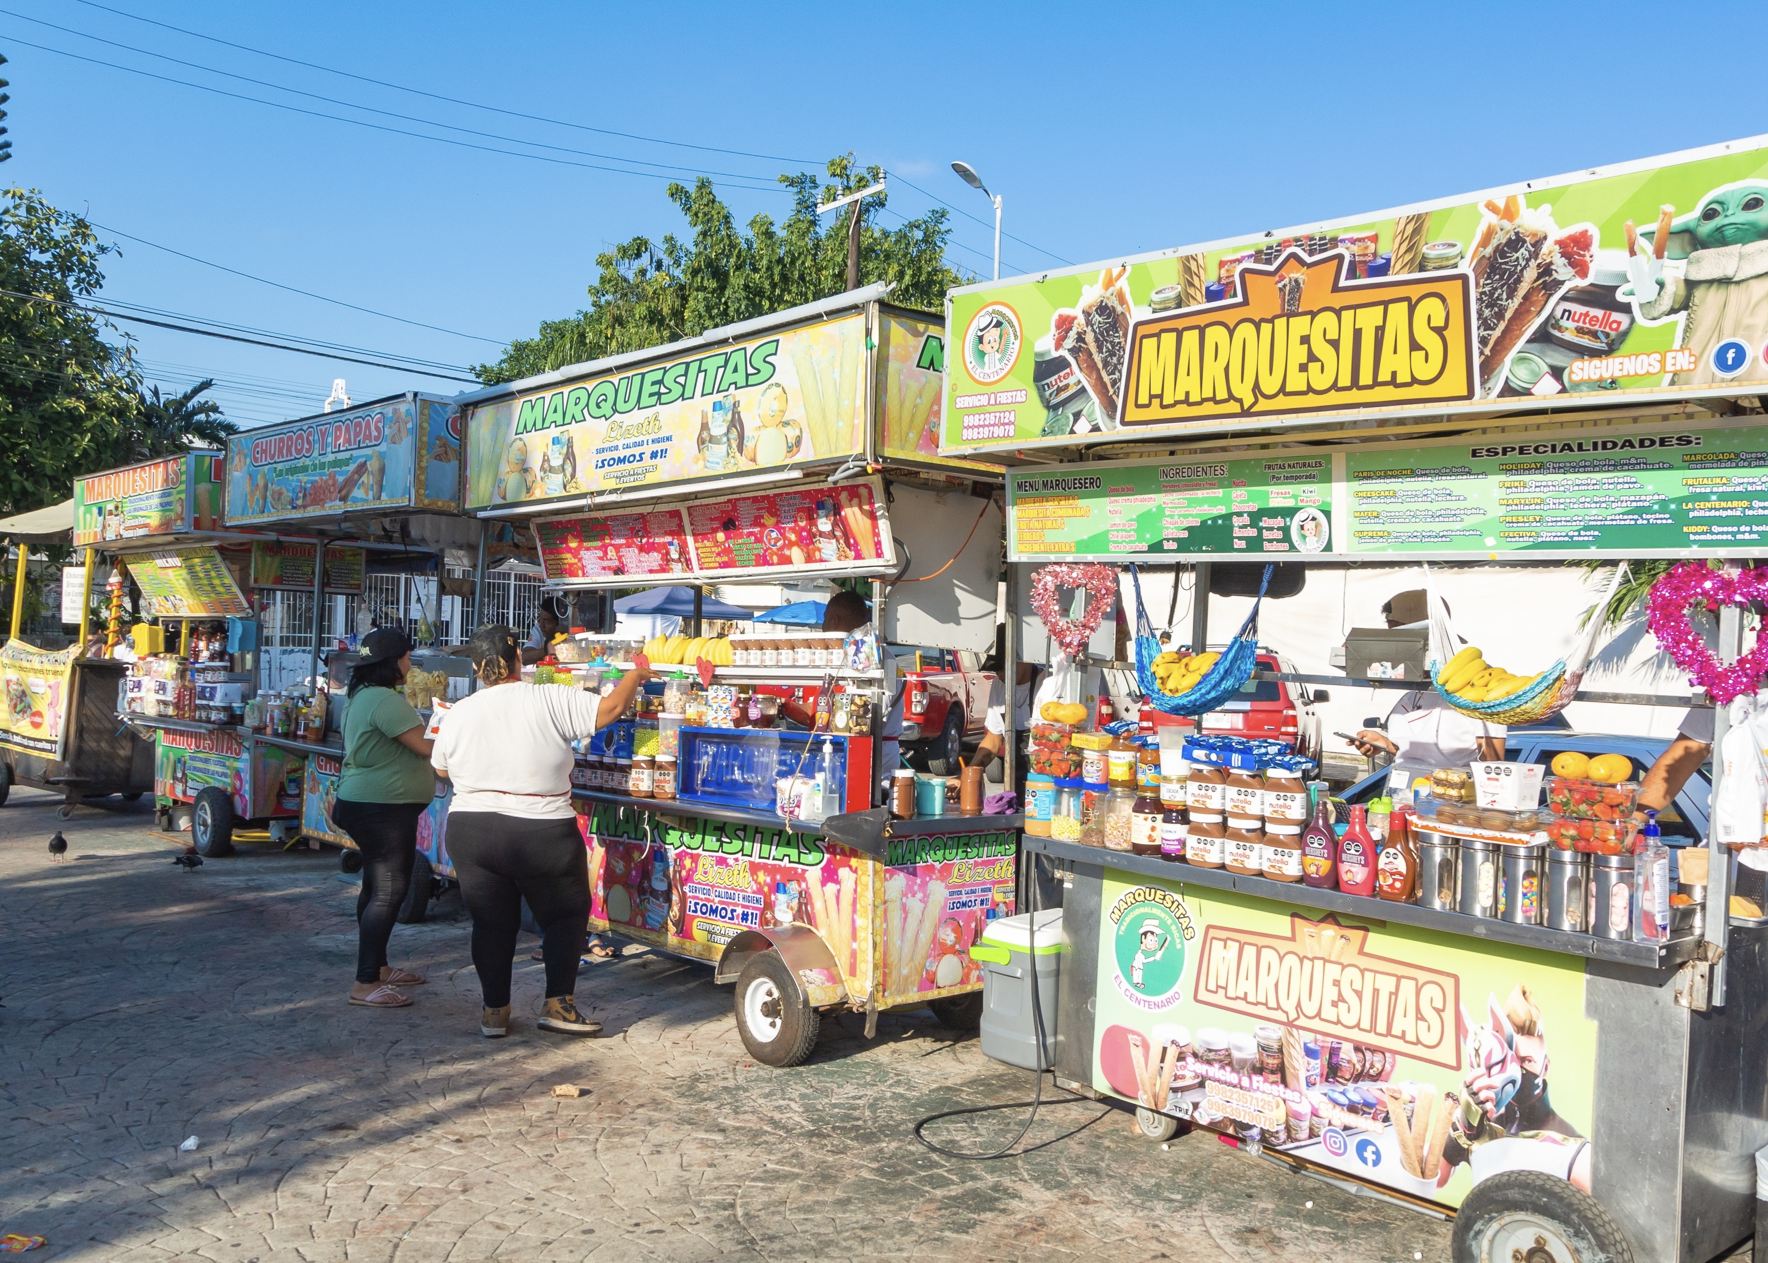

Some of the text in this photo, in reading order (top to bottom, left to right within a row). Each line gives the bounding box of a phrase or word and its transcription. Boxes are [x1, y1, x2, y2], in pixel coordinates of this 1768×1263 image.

[1560, 307, 1623, 333] nutella
[1135, 296, 1450, 413] MARQUESITAS
[1665, 350, 1695, 371] EN:
[978, 347, 1016, 380] CENTENARIO
[515, 338, 780, 436] MARQUESITAS
[1042, 368, 1076, 392] nutel
[955, 390, 1026, 408] SERVICIO A FIESTAS
[602, 412, 662, 443] Lizeth
[251, 427, 315, 467] CHURROS
[316, 423, 331, 455] Y
[332, 412, 385, 453] PAPAS
[622, 440, 645, 450] CALIDAD
[651, 435, 673, 444] HIGIENE
[1471, 434, 1703, 459] ESPECIALIDADES:
[595, 448, 668, 469] ¡SOMOS #1!
[1545, 461, 1577, 469] Queso
[1620, 457, 1647, 465] m&m
[1682, 451, 1767, 462] MARCOLADA: Queso
[604, 469, 631, 479] SERVICIO
[634, 465, 657, 475] FIESTAS
[1159, 465, 1228, 479] INGREDIENTES:
[1264, 461, 1324, 471] FRUTAS NATURALES:
[1505, 468, 1568, 477] philadelphia,
[1600, 464, 1615, 472] de
[1616, 462, 1673, 471] cacahuate.
[1689, 461, 1737, 469] mermelada
[84, 458, 181, 505] MARQUESITAS
[1042, 477, 1102, 492] MARQUESERO
[1270, 473, 1318, 482] (Por temporada)
[1528, 479, 1561, 488] Queso
[1602, 476, 1637, 484] nutella
[1682, 476, 1759, 486] FRUTALIKA: Queso
[1569, 483, 1600, 492] jamón
[1601, 482, 1615, 490] de
[1616, 482, 1644, 491] pavo.
[1712, 485, 1745, 493] natural,
[1747, 484, 1768, 492] kiwi,
[1505, 500, 1653, 512] philadelphia, lechera, plátano.
[1545, 497, 1577, 505] Queso
[1620, 494, 1669, 502] mazapán,
[1682, 500, 1750, 510] LA CENTENARIO:
[1607, 513, 1642, 521] plátano,
[1689, 509, 1744, 518] philadelphia,
[1711, 525, 1738, 533] Queso
[1230, 797, 1252, 806] nutella
[1269, 802, 1292, 810] nutella
[885, 832, 1016, 867] MARQUESITAS
[1191, 845, 1211, 854] nutella
[1229, 851, 1251, 860] nutella
[1267, 857, 1288, 866] nutella
[694, 853, 752, 890] Lizeth
[948, 858, 1014, 884] Lizeth
[715, 889, 737, 901] CALIDAD
[742, 894, 762, 906] HIGIENE
[949, 899, 977, 910] ¡SOMOS
[687, 900, 758, 925] ¡SOMOS #1!
[1110, 887, 1195, 941] MARQUESITAS
[697, 921, 720, 933] SERVICIO
[1113, 974, 1181, 1010] EL CENTENARIO
[1205, 938, 1446, 1050] MARQUESITAS
[1186, 1056, 1302, 1103] Servicio a Fiestas
